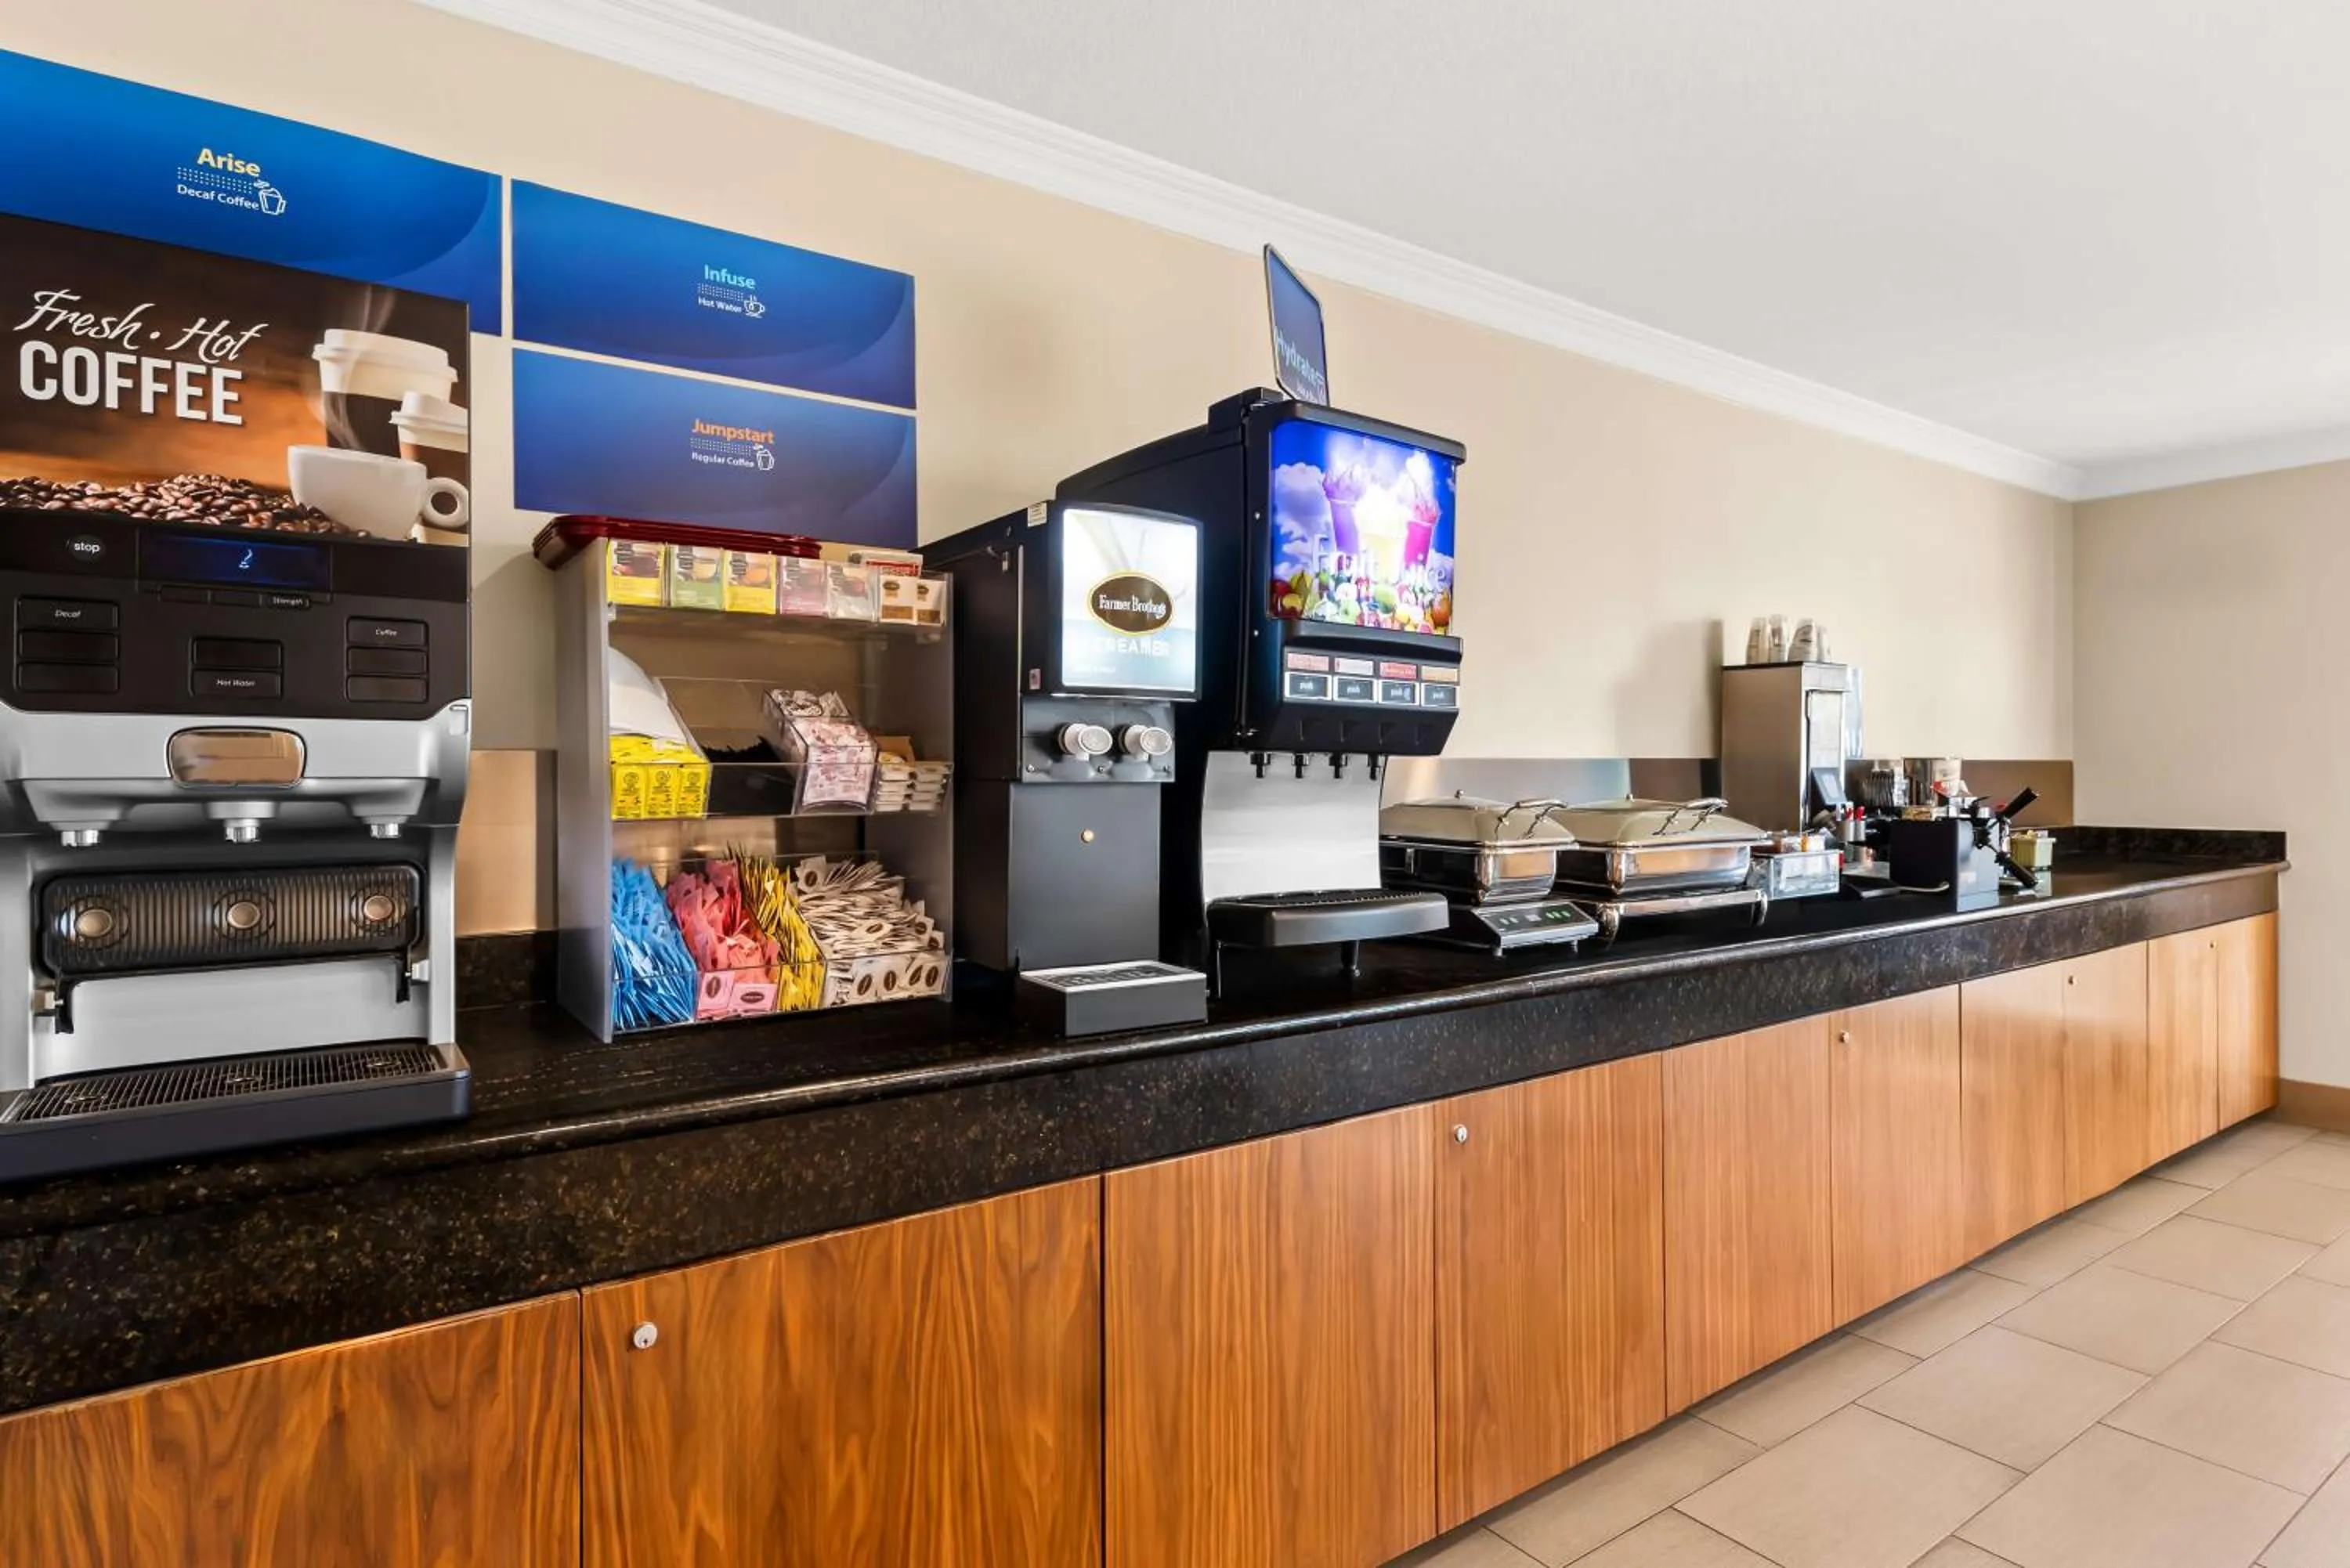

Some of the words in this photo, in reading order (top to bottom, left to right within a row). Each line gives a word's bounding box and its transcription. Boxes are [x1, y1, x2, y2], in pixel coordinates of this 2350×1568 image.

[197, 147, 261, 177] Arise
[176, 183, 215, 201] Decaf
[217, 193, 259, 211] Coffee
[704, 263, 756, 289] Infuse
[698, 296, 714, 308] Hot
[715, 301, 743, 313] Water
[13, 289, 155, 350] Fresh
[165, 317, 269, 364] Hot
[1273, 325, 1325, 388] Hydrate
[20, 340, 243, 425] COFFEE
[692, 418, 775, 444] Jumpstart
[691, 452, 725, 464] Regular
[726, 456, 755, 468] Coffee
[74, 542, 100, 555] stop
[1098, 594, 1132, 611] Farmer
